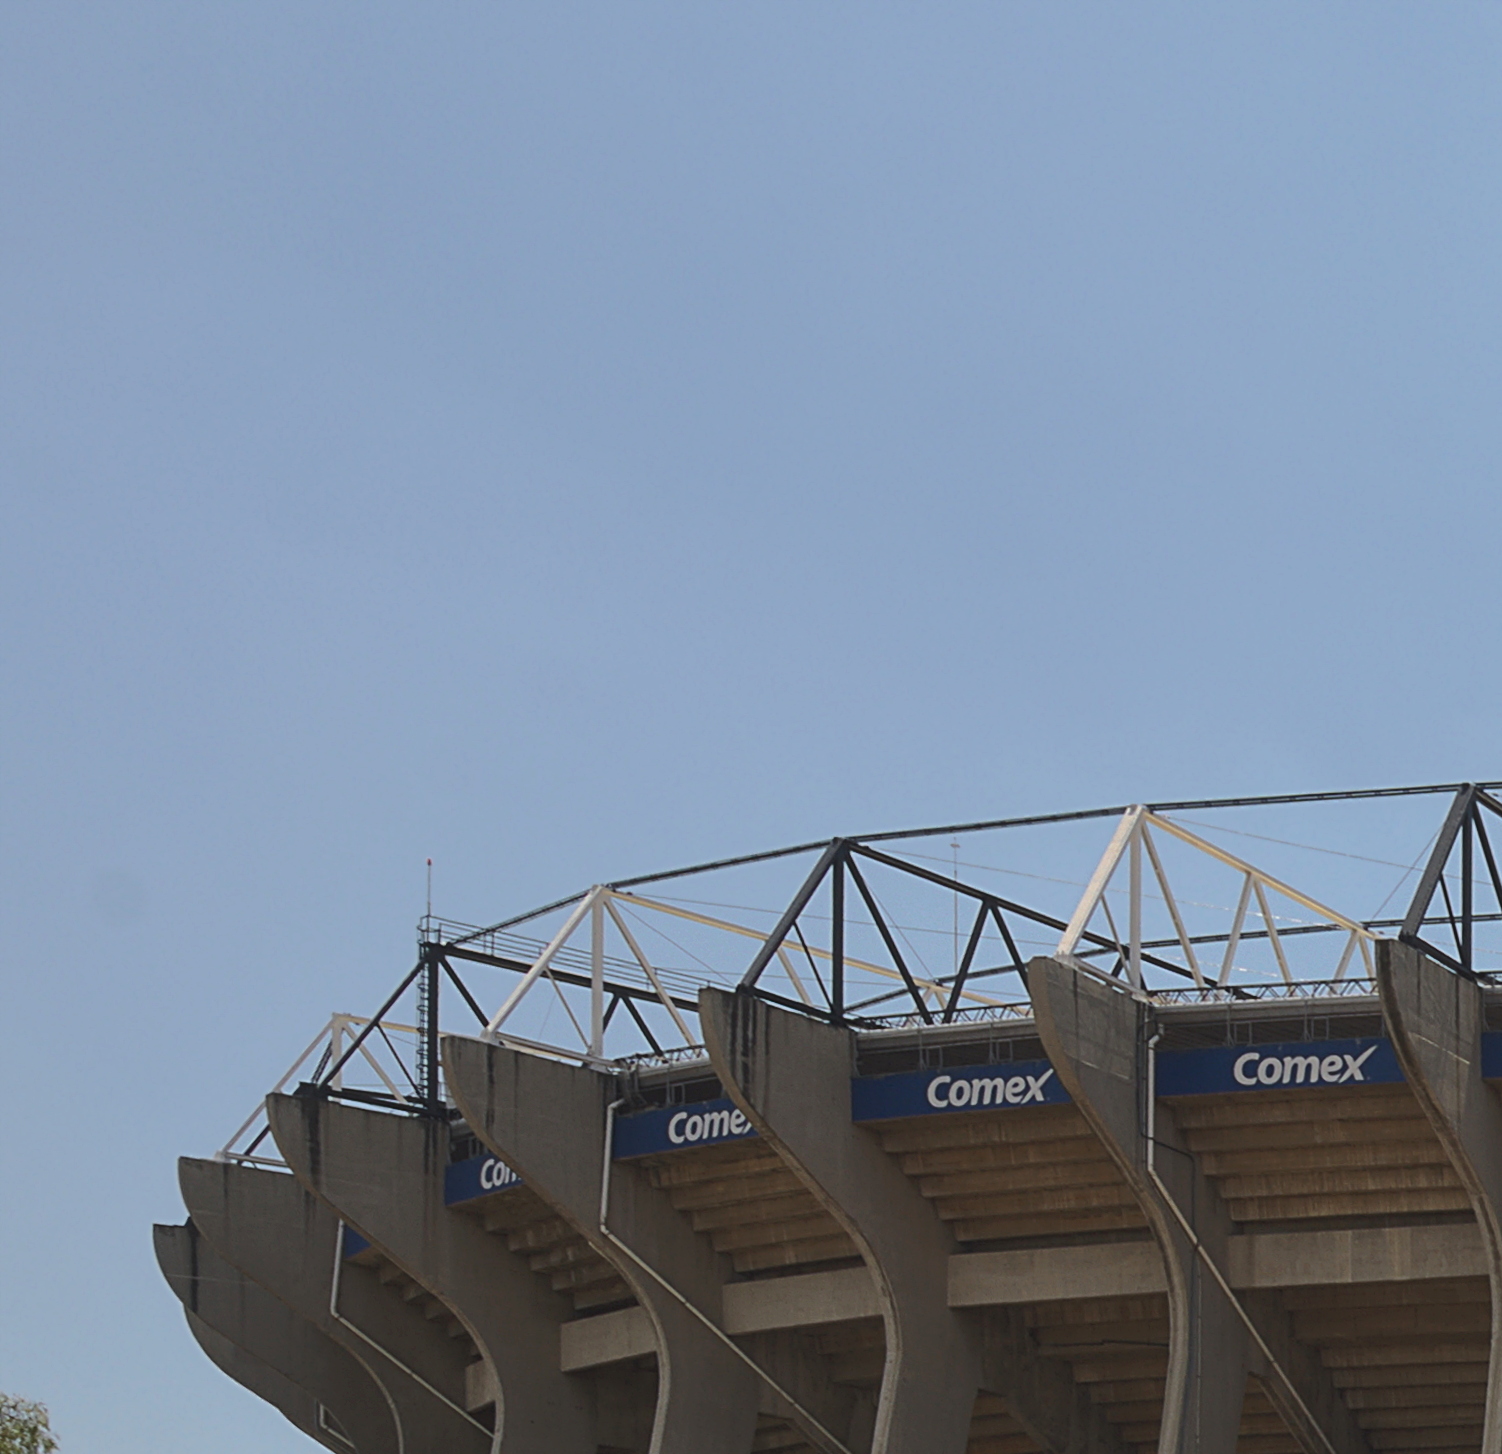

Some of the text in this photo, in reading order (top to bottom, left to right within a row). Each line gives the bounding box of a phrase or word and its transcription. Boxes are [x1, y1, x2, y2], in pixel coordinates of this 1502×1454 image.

[1233, 1046, 1376, 1085] Comex
[927, 1068, 1054, 1108] Comex
[668, 1109, 752, 1144] Come
